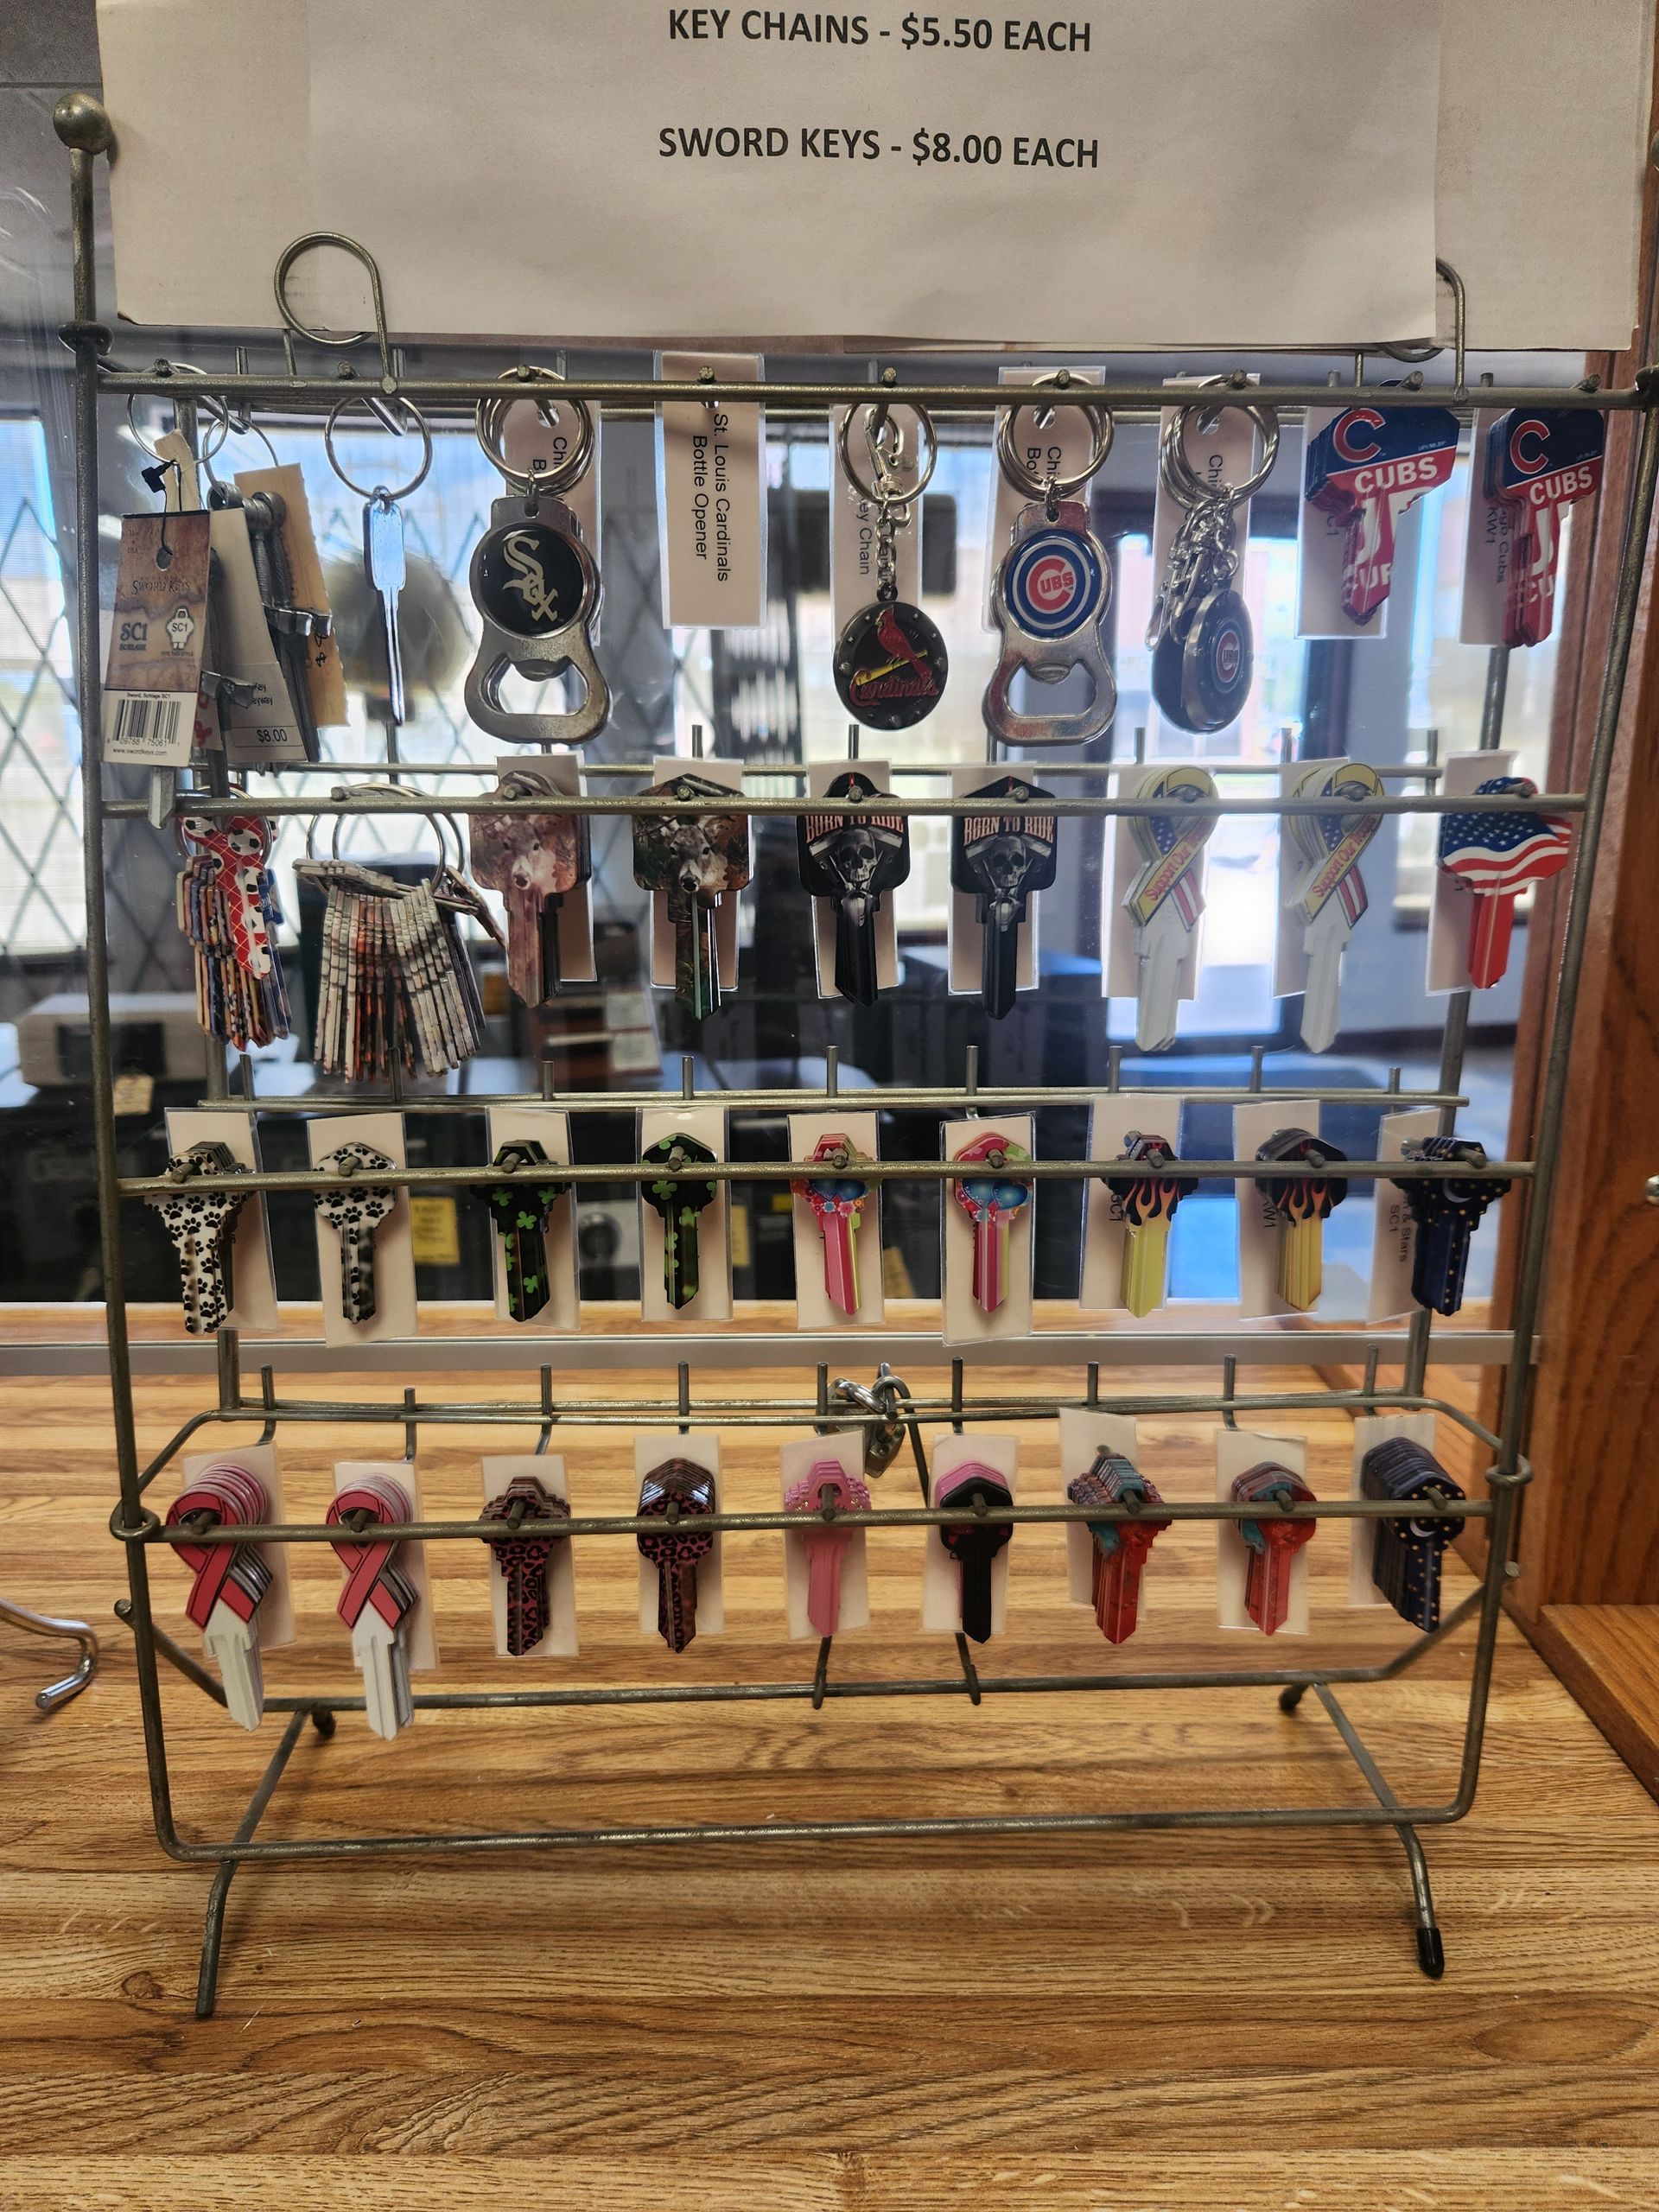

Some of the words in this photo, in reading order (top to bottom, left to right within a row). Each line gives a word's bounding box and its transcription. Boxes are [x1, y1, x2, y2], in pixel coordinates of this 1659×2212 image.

[670, 10, 730, 40] KEY
[742, 10, 868, 45] CHAINS
[901, 12, 993, 49] $5.50
[1004, 20, 1090, 52] EACH
[659, 127, 788, 157] SWORD
[801, 129, 880, 159] KEYS
[912, 128, 1002, 166] $8.00
[1014, 137, 1098, 168] EACH
[713, 413, 728, 436] St.
[1333, 408, 1386, 463] C
[692, 435, 708, 487] Bottle
[1510, 419, 1551, 474] C
[715, 445, 730, 493] Louis
[1354, 456, 1438, 494] CUBS
[1529, 465, 1592, 505] CUBS
[691, 493, 709, 561] Opener
[715, 498, 731, 582] Cardinals
[859, 527, 872, 575] Chain
[120, 622, 148, 642] SC1
[171, 622, 188, 632] SC1
[251, 696, 273, 706] eyway
[256, 728, 288, 743] $8.00
[963, 816, 1001, 846] BORN
[1003, 816, 1020, 831] TO
[1024, 816, 1054, 844] RIDE
[1144, 862, 1179, 902] Support
[1312, 858, 1344, 898] Support
[1338, 841, 1357, 862] Our
[1389, 1205, 1400, 1232] SC1
[1399, 1227, 1411, 1262] Stars
